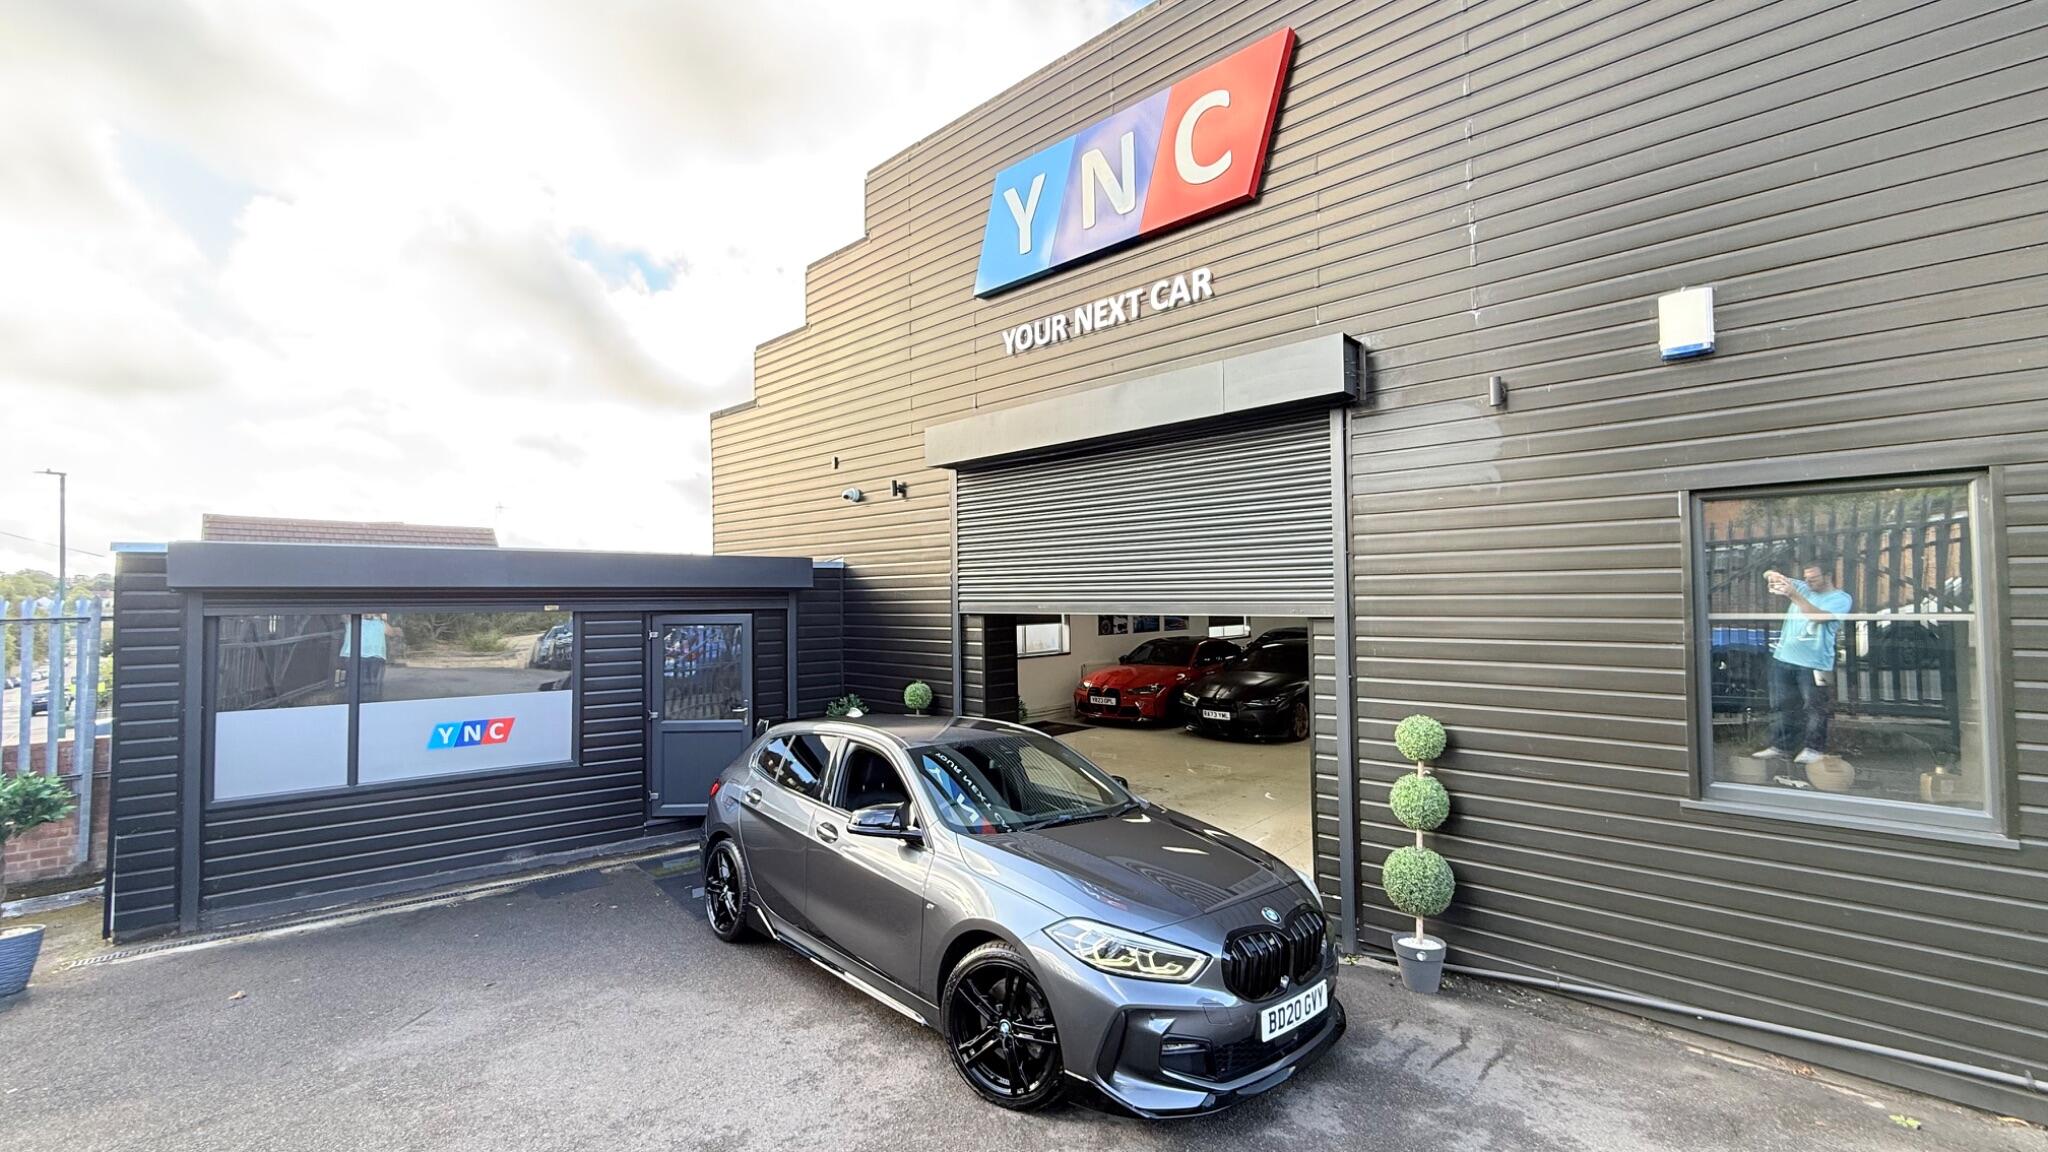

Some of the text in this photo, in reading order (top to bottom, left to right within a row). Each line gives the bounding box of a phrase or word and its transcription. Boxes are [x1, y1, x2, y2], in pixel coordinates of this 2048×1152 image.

[1003, 89, 1233, 255] YNC
[1001, 267, 1215, 355] YOUR NEXT CAR
[437, 722, 505, 745] YNC
[1268, 985, 1324, 1034] BD20 GVY
